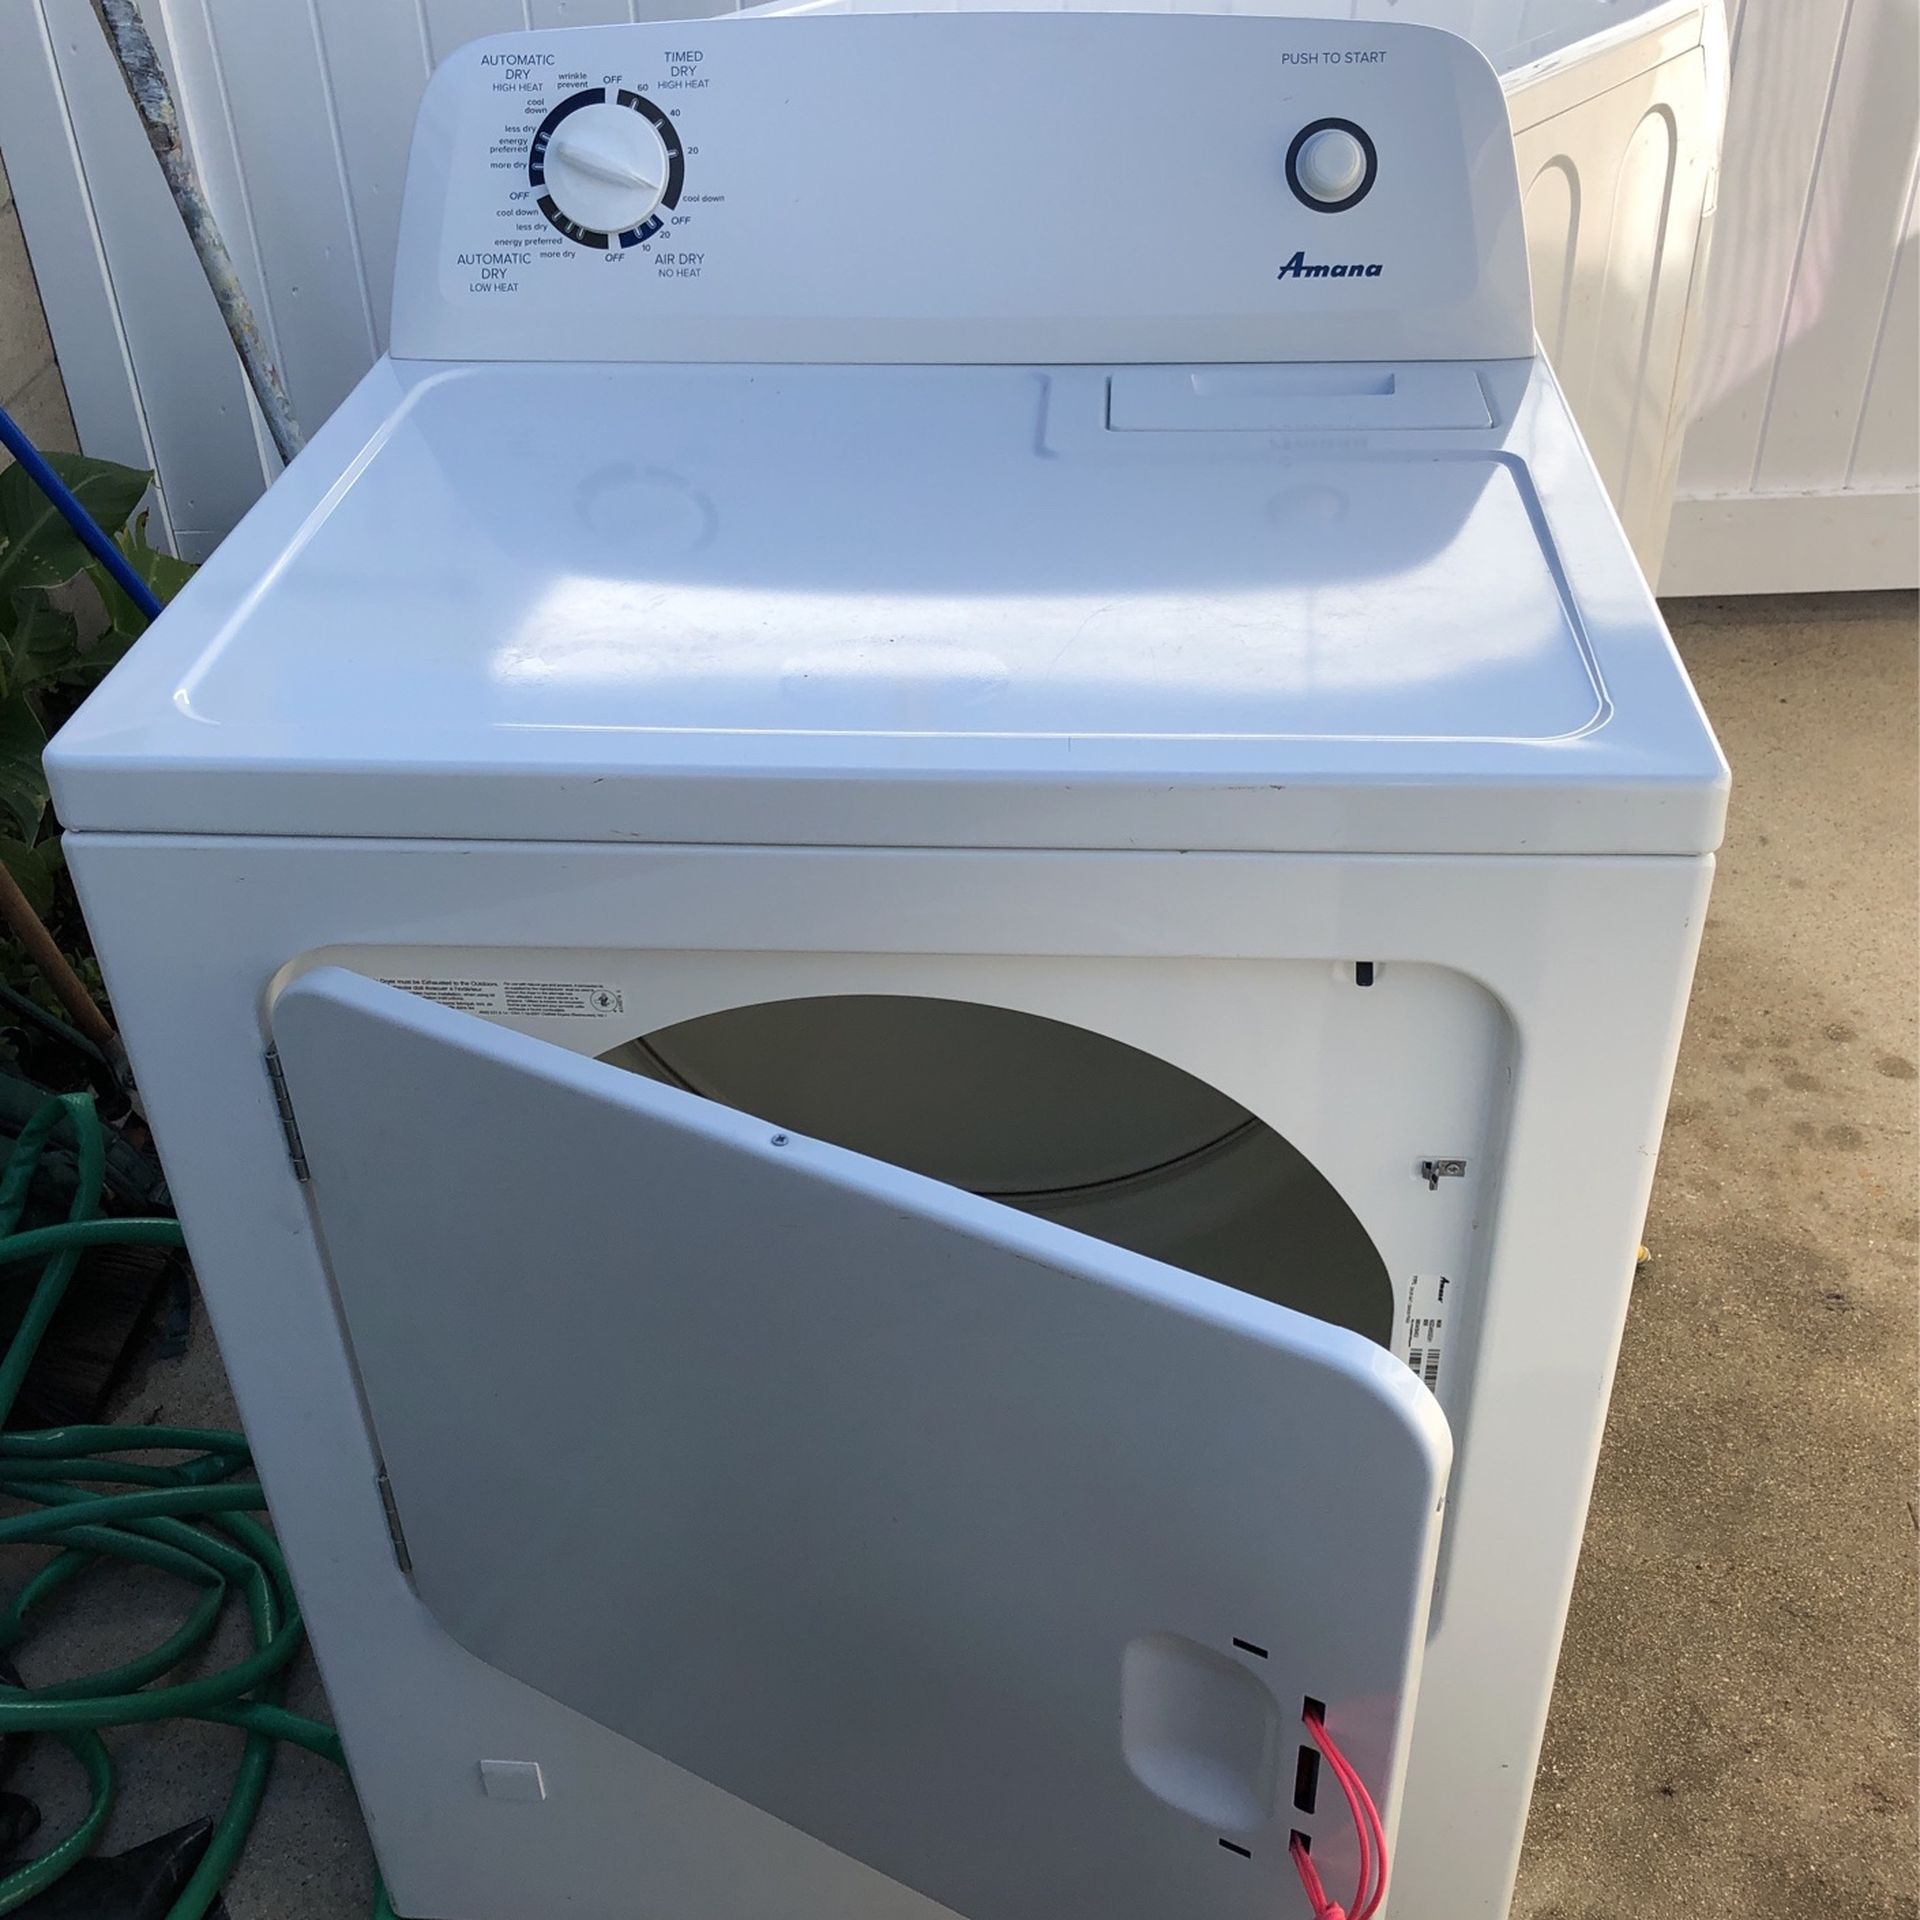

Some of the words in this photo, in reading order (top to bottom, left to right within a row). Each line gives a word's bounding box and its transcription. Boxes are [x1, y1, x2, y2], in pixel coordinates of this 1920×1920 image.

[480, 54, 555, 66] AUTOMATIC
[664, 51, 704, 63] TIMED
[1282, 52, 1319, 65] PUSH
[1323, 52, 1341, 64] TO
[1344, 51, 1387, 63] START
[505, 69, 530, 80] DRY
[558, 71, 587, 80] wrinkle
[671, 65, 697, 77] DRY
[557, 81, 589, 89] prevent
[603, 75, 622, 85] OFF
[657, 80, 683, 89] HIGH
[685, 79, 710, 89] HEAT
[492, 83, 516, 92] HIGH
[518, 83, 544, 92] HEAT
[637, 83, 649, 92] 60
[527, 98, 545, 106] cool
[670, 108, 681, 117] 40
[505, 125, 520, 133] less
[522, 124, 537, 134] dry
[499, 137, 528, 145] energy
[490, 145, 528, 153] preferred
[687, 146, 699, 154] 20
[513, 160, 527, 170] dry
[510, 191, 530, 201] OFF
[683, 195, 699, 203] cool
[702, 194, 725, 202] down
[496, 209, 515, 217] cool
[516, 208, 539, 217] down
[671, 216, 691, 226] OFF
[516, 223, 531, 231] less
[533, 222, 548, 232] dry
[659, 231, 671, 239] 20
[494, 239, 523, 248] energy
[524, 236, 563, 246] preferred
[642, 244, 651, 252] 10
[457, 253, 531, 265] AUTOMATIC
[540, 251, 560, 259] more
[562, 250, 576, 260] dry
[605, 253, 625, 263] OFF
[655, 253, 675, 265] AIR
[679, 253, 705, 265] DRY
[1277, 251, 1383, 280] Amana
[481, 268, 507, 280] DRY
[658, 268, 673, 278] NO
[676, 268, 701, 277] HEAT
[470, 283, 492, 293] LOW
[494, 283, 519, 293] HEAT
